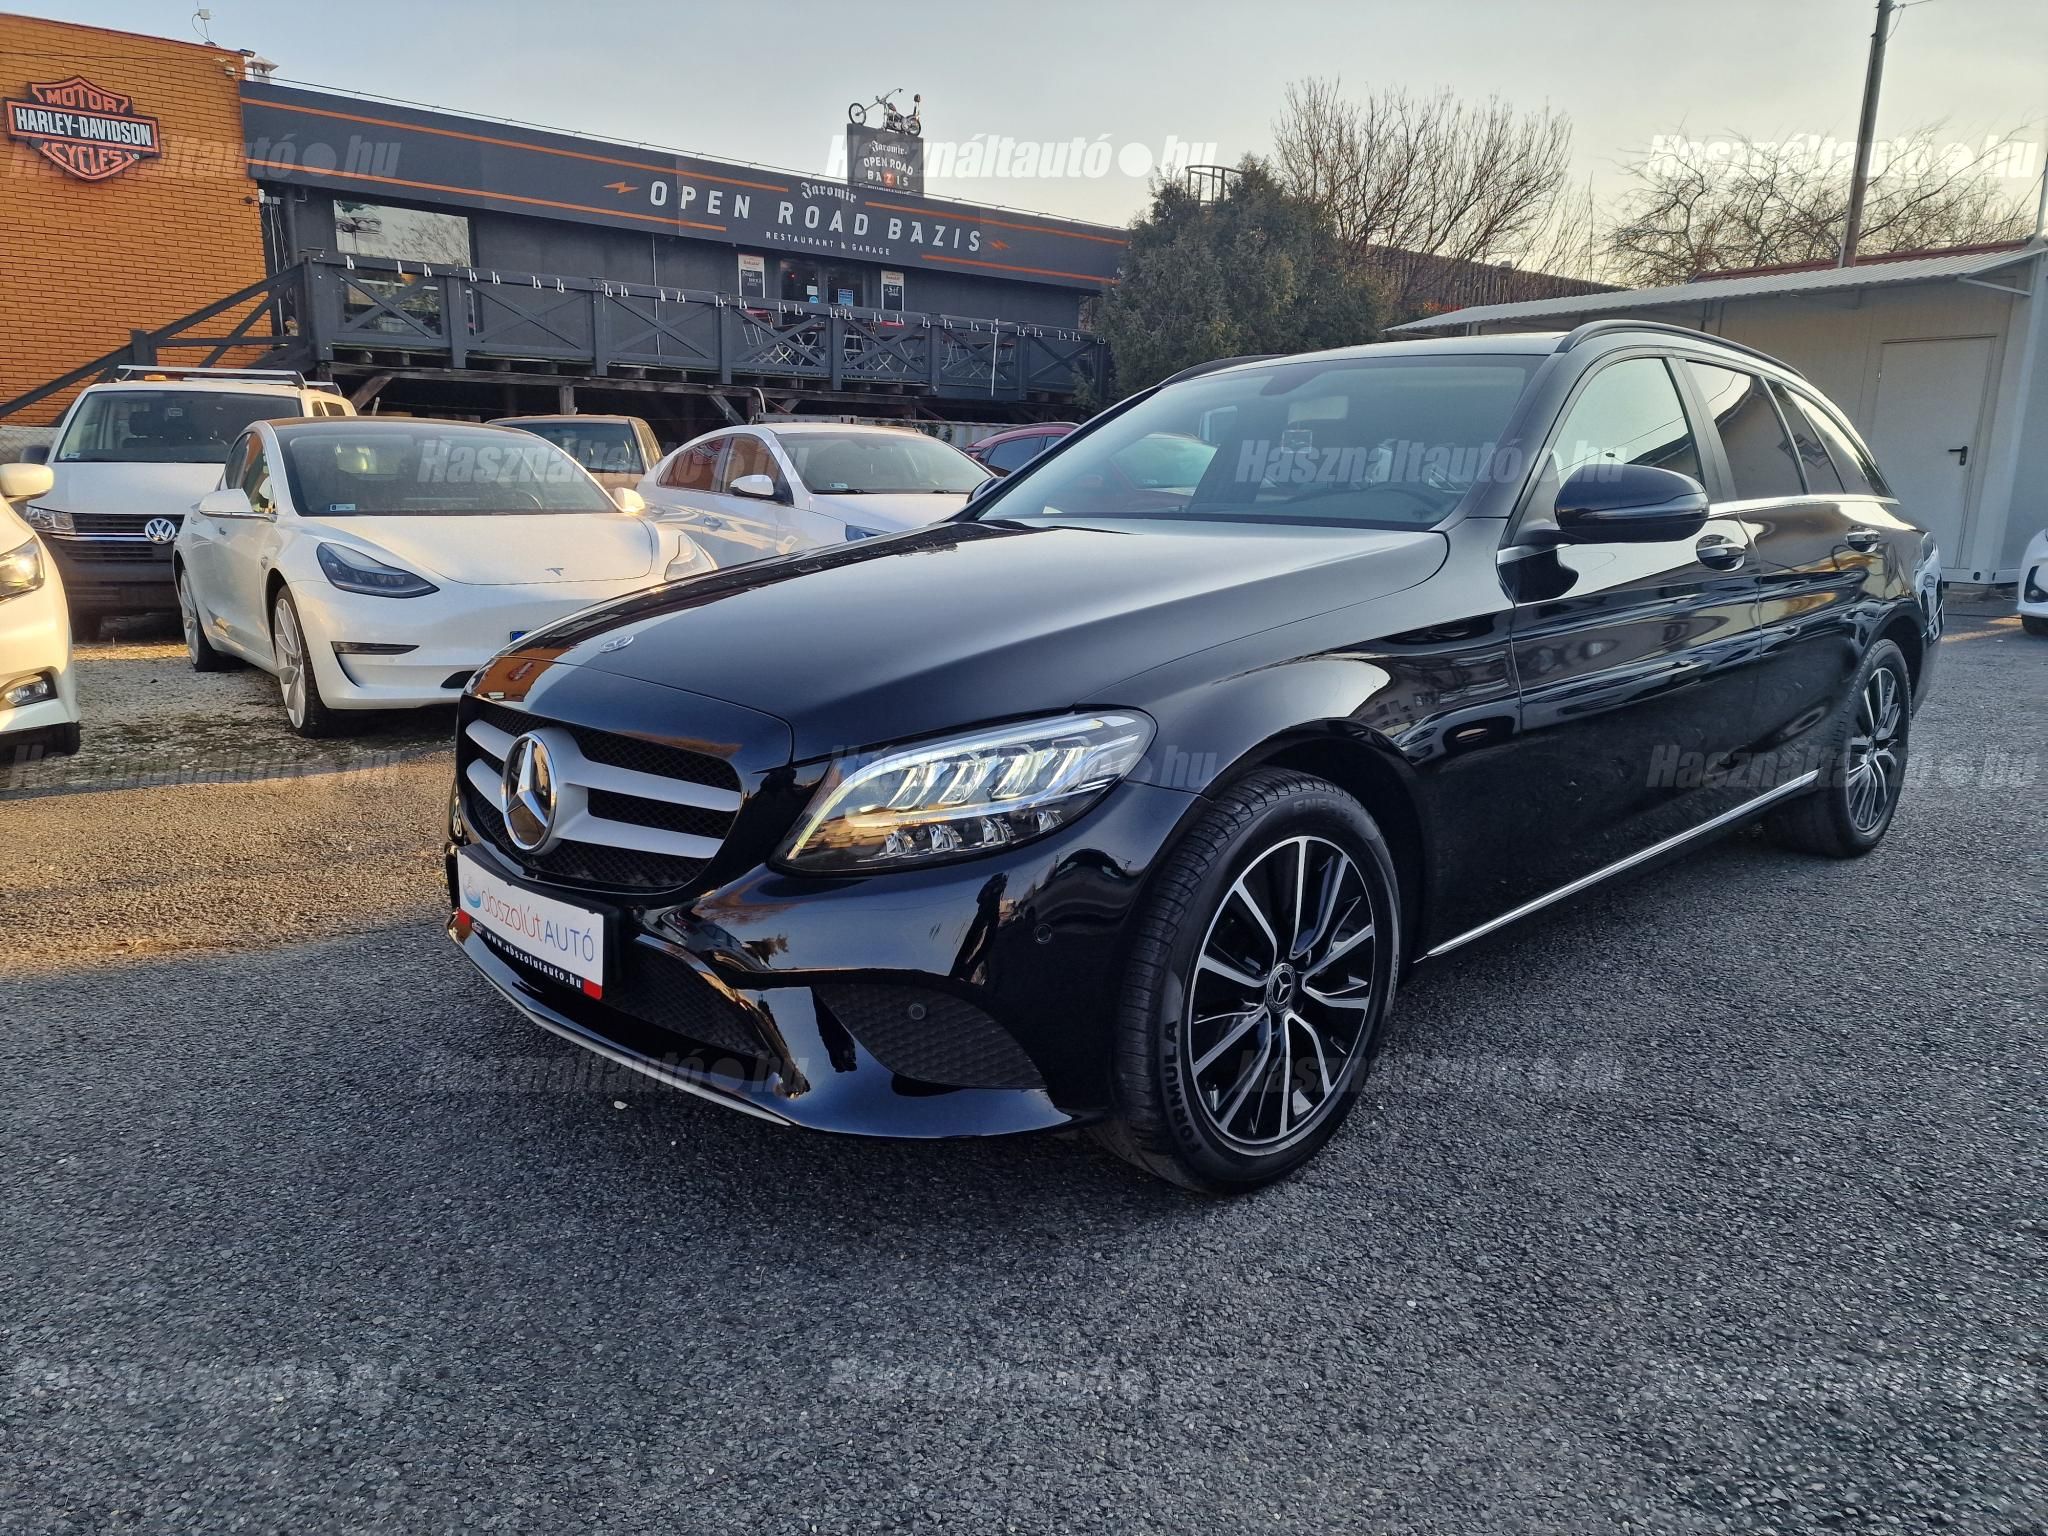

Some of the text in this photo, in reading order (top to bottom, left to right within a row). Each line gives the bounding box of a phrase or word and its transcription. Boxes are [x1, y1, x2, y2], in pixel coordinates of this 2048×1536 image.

[46, 84, 117, 113] MOTOR
[16, 107, 152, 146] HARLEY-DAVIDSON
[51, 142, 123, 175] CYCLES
[871, 140, 905, 155] Jaromir
[864, 156, 914, 176] OPEN ROAD
[800, 181, 857, 204] Jaromir
[650, 180, 751, 219] OPEN
[777, 200, 869, 236] ROAD
[765, 231, 834, 248] RESTAURANT
[851, 243, 890, 256] GARAGE
[486, 931, 581, 989] www.abszolutauto.hu
